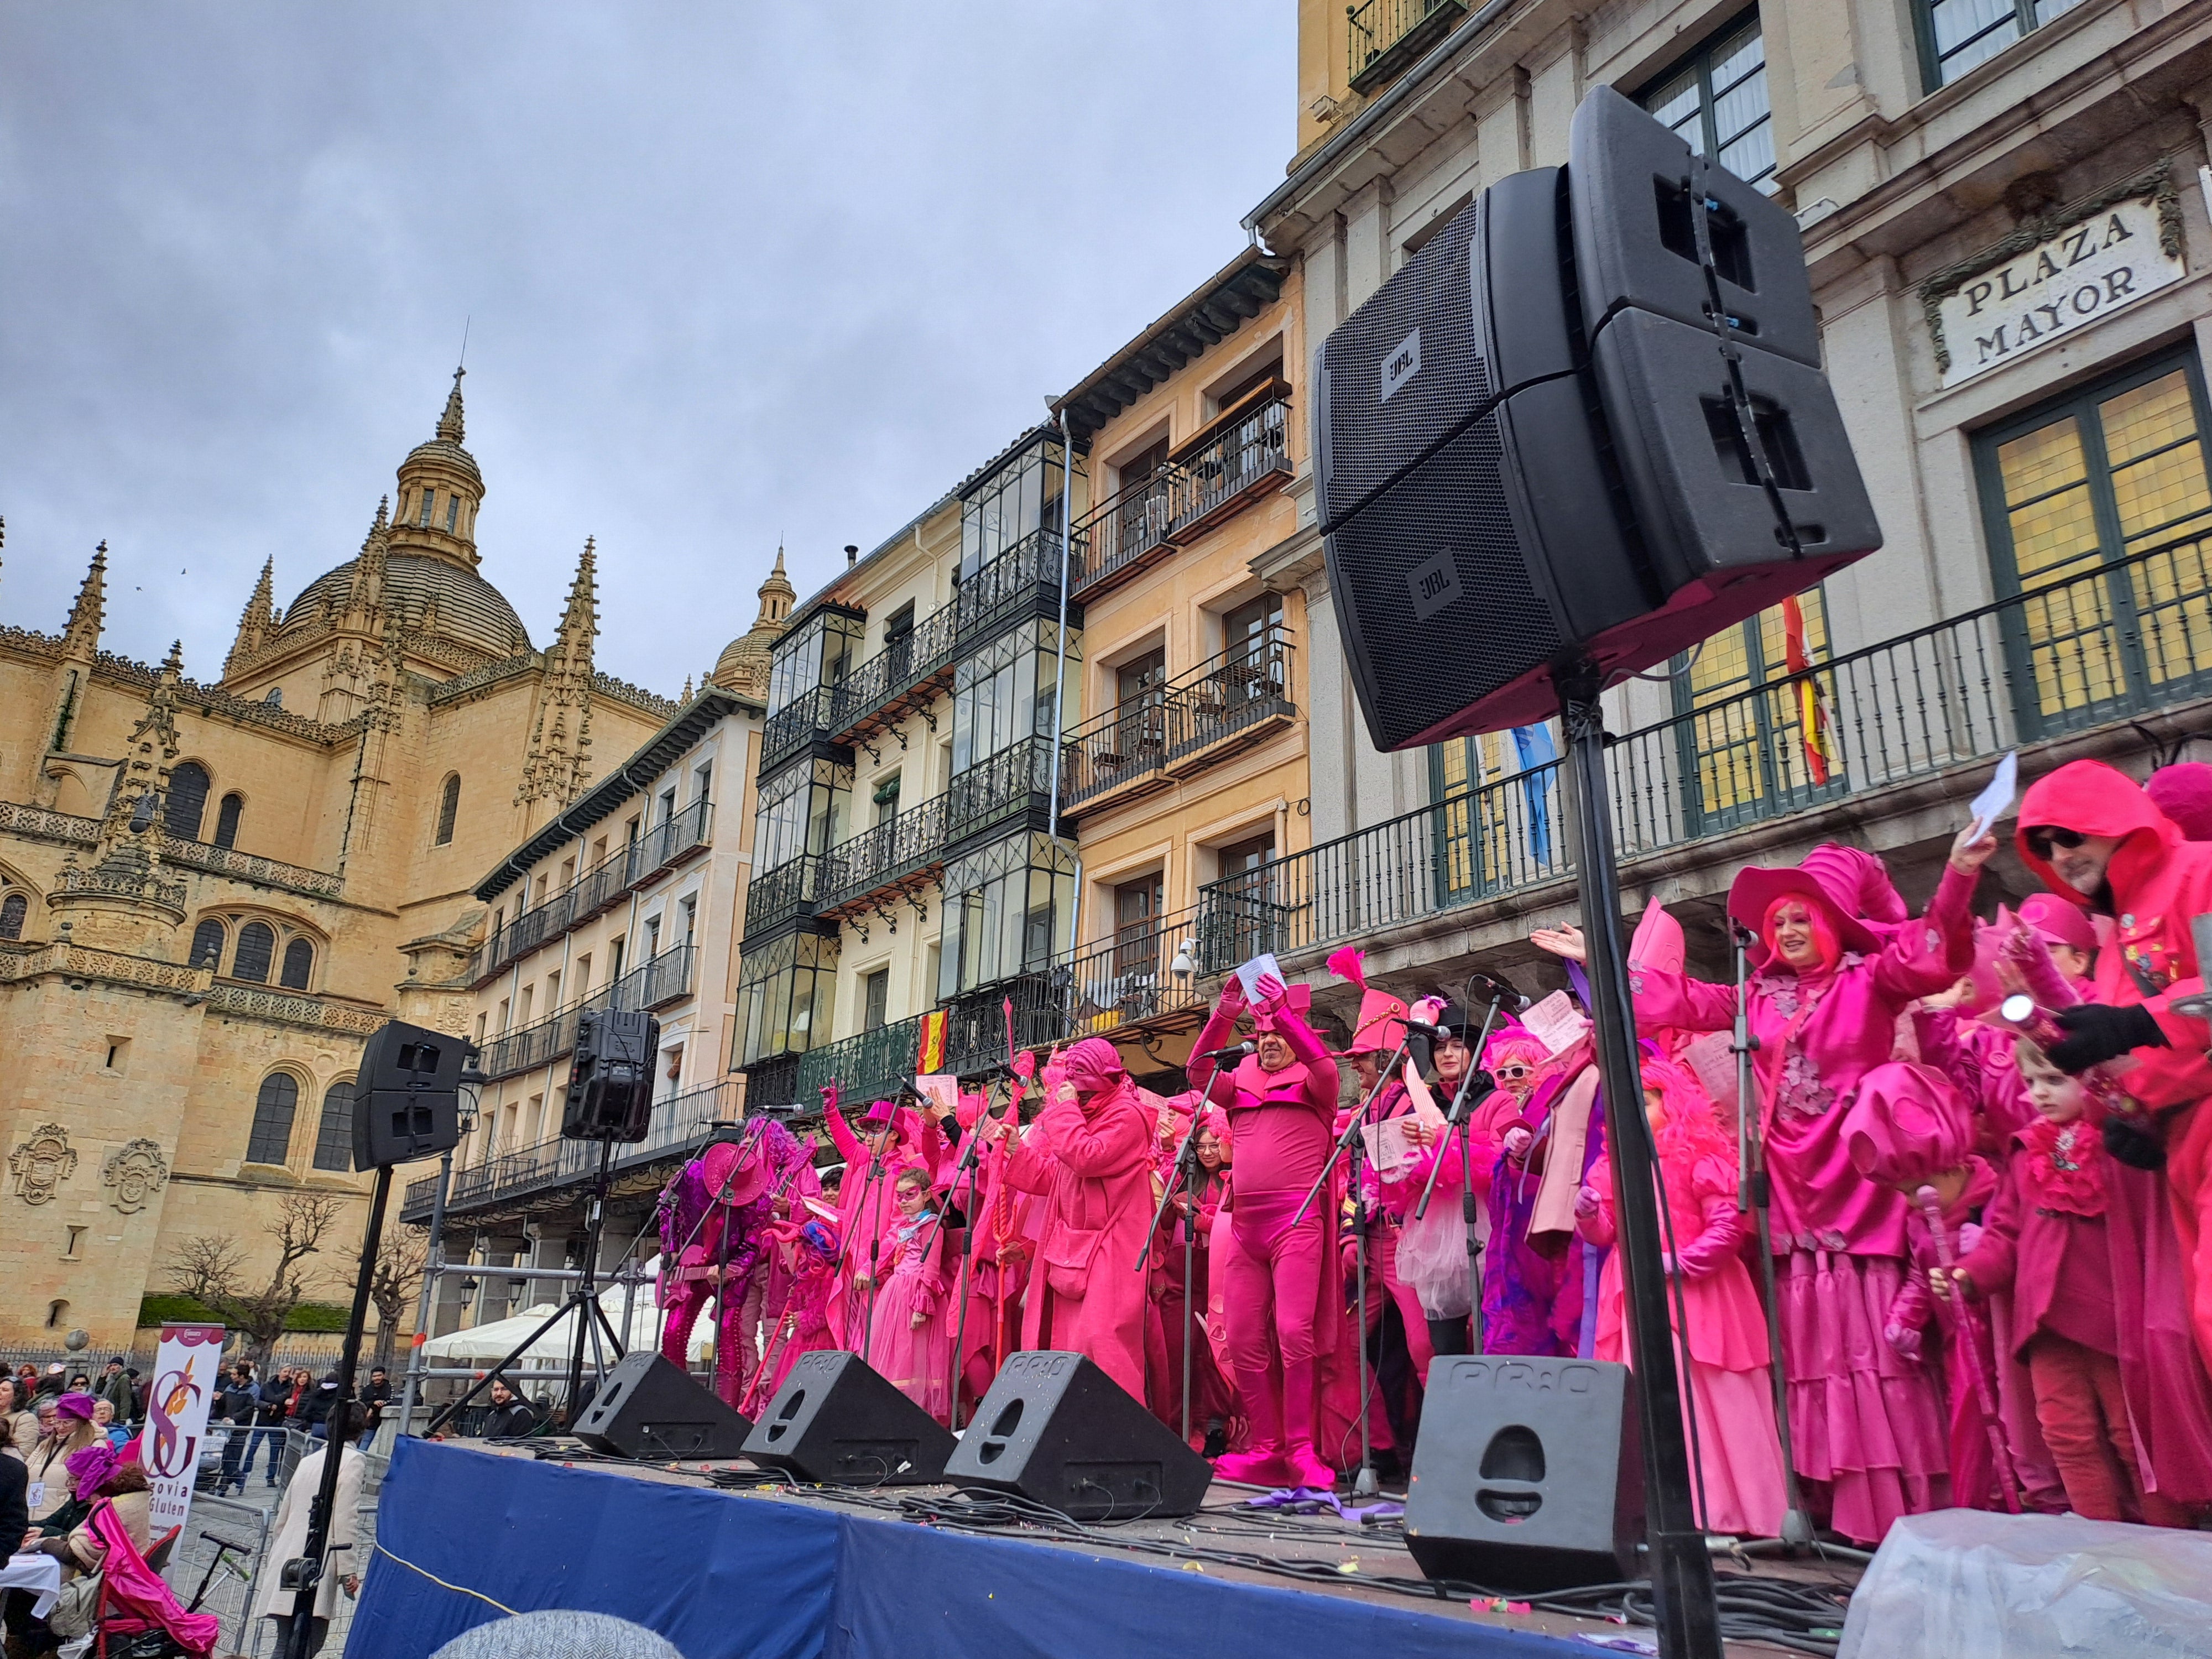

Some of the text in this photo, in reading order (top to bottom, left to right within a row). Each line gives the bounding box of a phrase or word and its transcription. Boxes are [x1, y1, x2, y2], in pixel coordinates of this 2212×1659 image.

[1967, 213, 2133, 317] PLAZA
[1975, 267, 2136, 365] MAYOR
[1390, 349, 1413, 381] JBL
[1419, 569, 1450, 600] JBL
[149, 1481, 188, 1498] govia
[149, 1497, 185, 1516] Gluten
